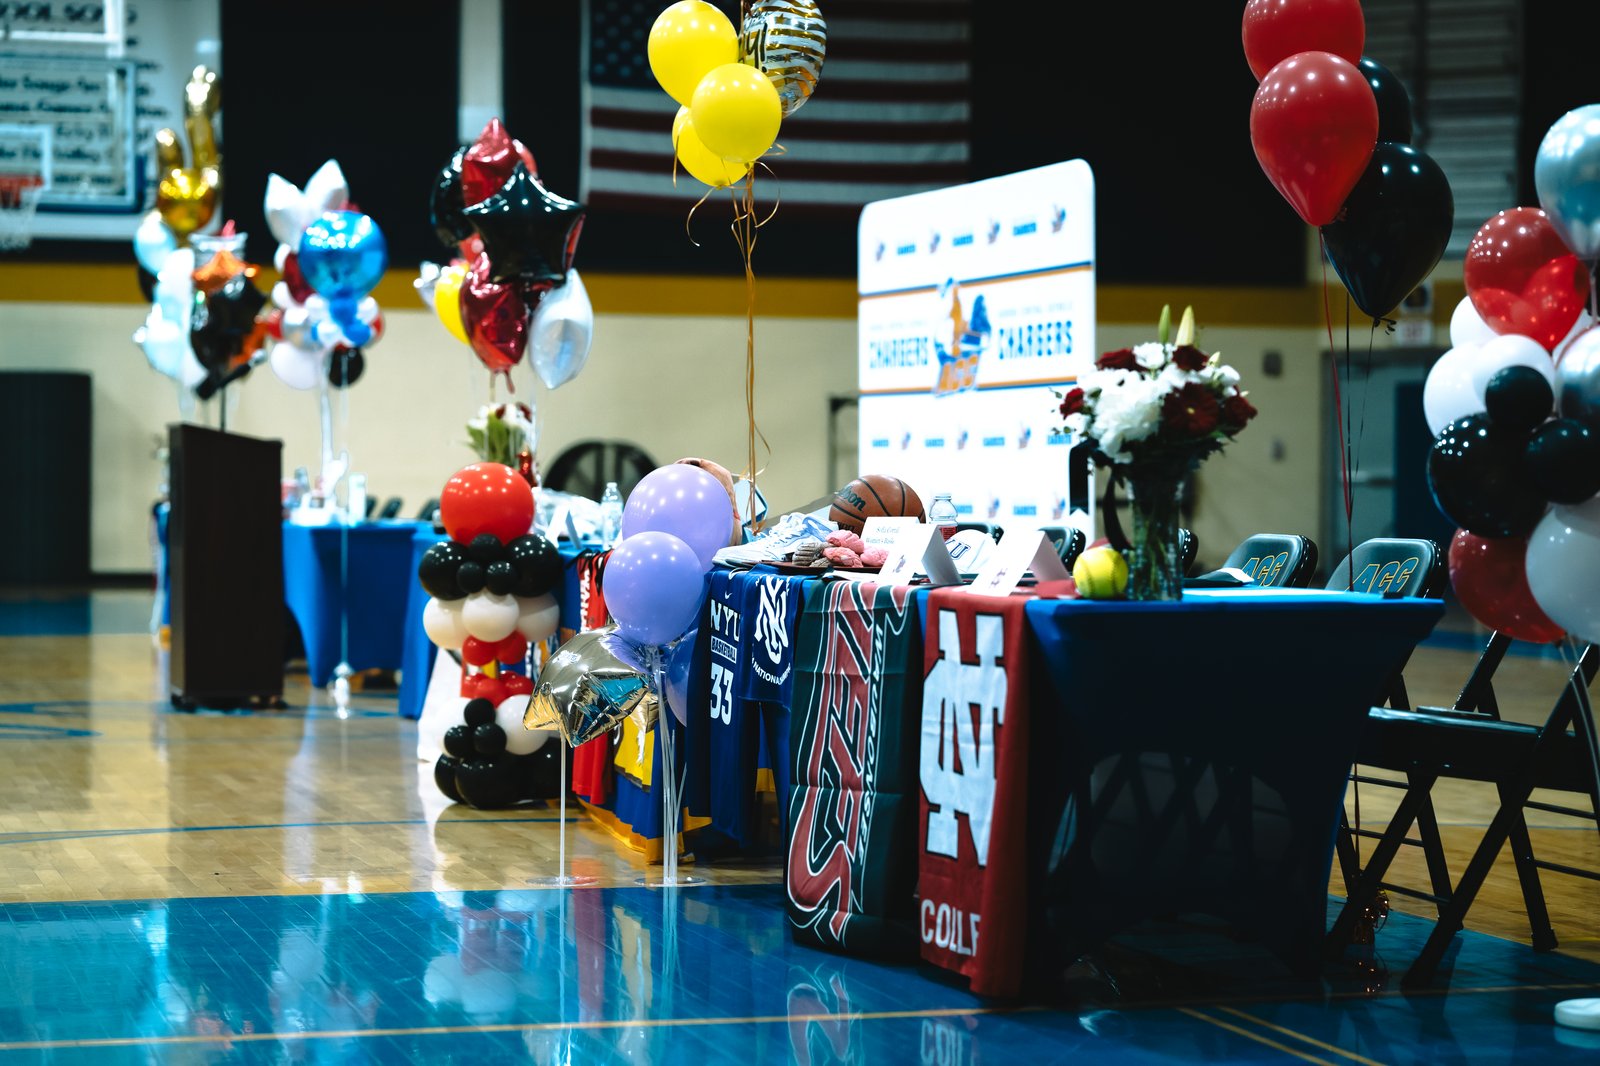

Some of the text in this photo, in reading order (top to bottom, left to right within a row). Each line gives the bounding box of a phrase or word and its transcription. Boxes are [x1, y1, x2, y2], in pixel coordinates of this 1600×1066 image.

[998, 320, 1073, 360] CHARGERS
[710, 598, 742, 642] NYU
[709, 661, 734, 726] 33
